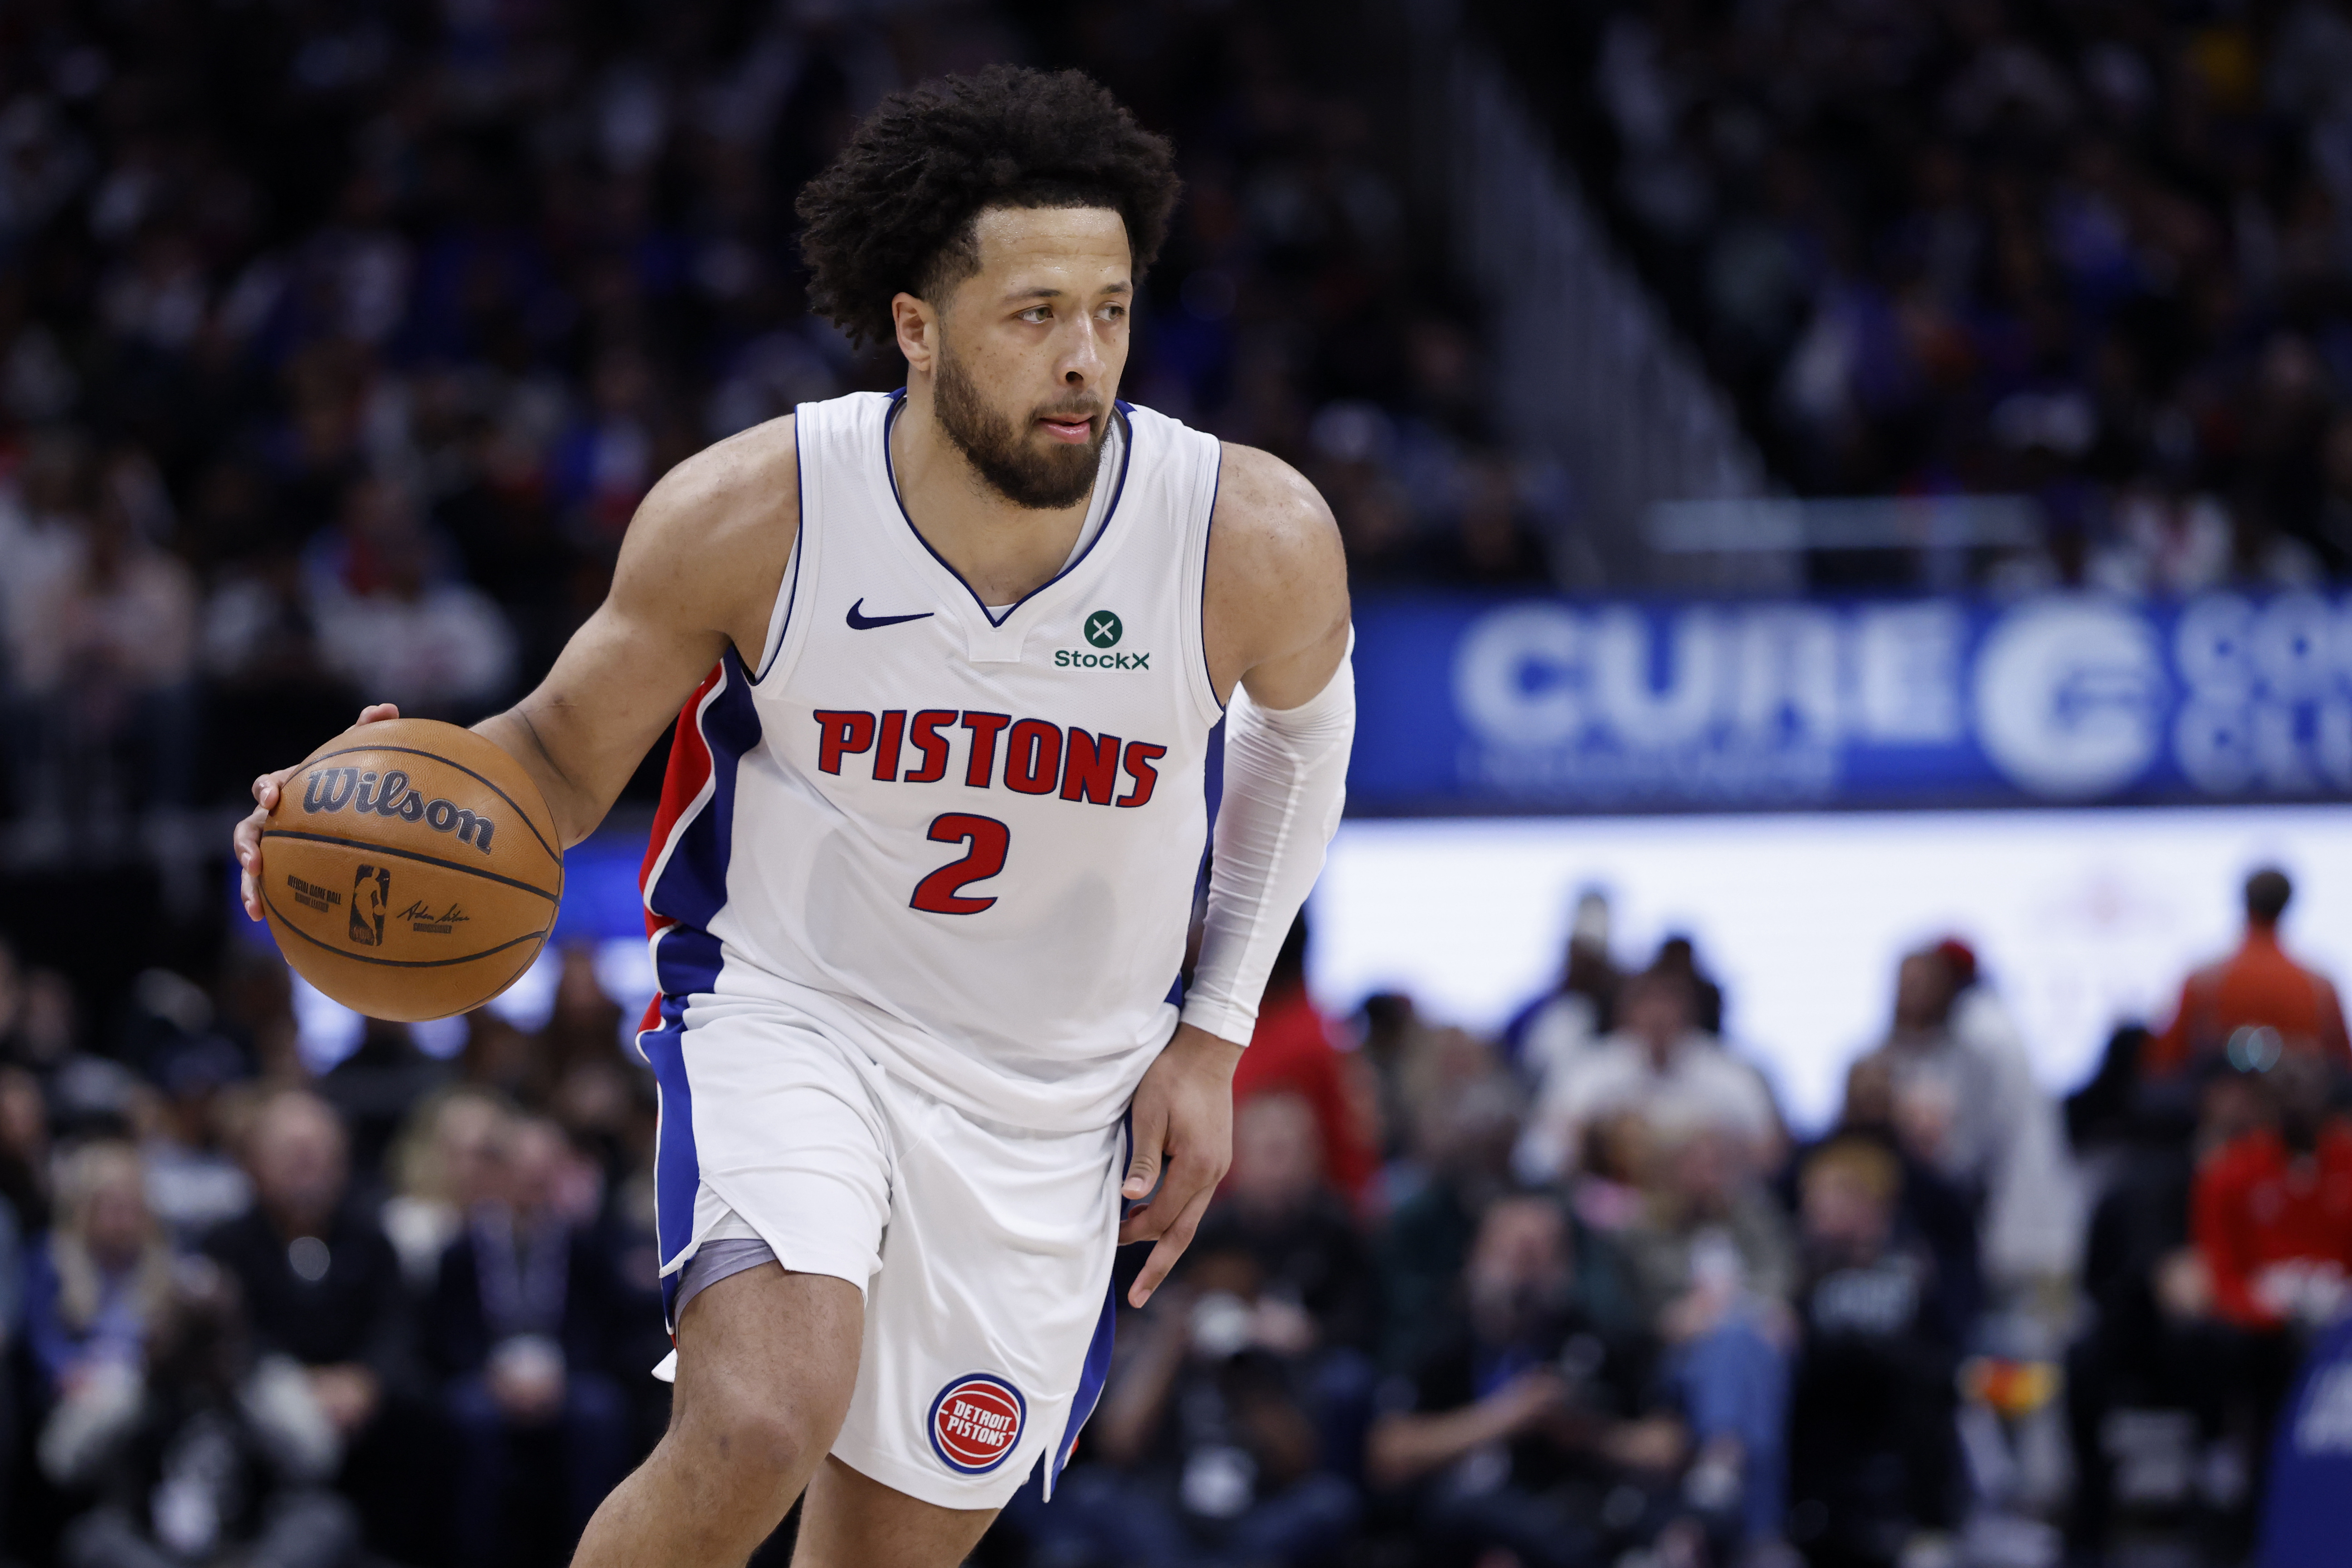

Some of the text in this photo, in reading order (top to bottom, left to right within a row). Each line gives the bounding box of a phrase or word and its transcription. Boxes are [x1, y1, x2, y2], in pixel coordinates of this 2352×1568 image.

[1054, 650, 1149, 670] StockX
[813, 709, 1168, 808] PISTONS
[303, 767, 495, 855] Wilson
[908, 812, 1011, 916] 2
[287, 874, 308, 894] OFFICIAL
[310, 884, 326, 900] GAME
[326, 890, 341, 905] BALL
[946, 1415, 1007, 1447] PISTONS
[953, 1399, 1013, 1432] DETROIT
